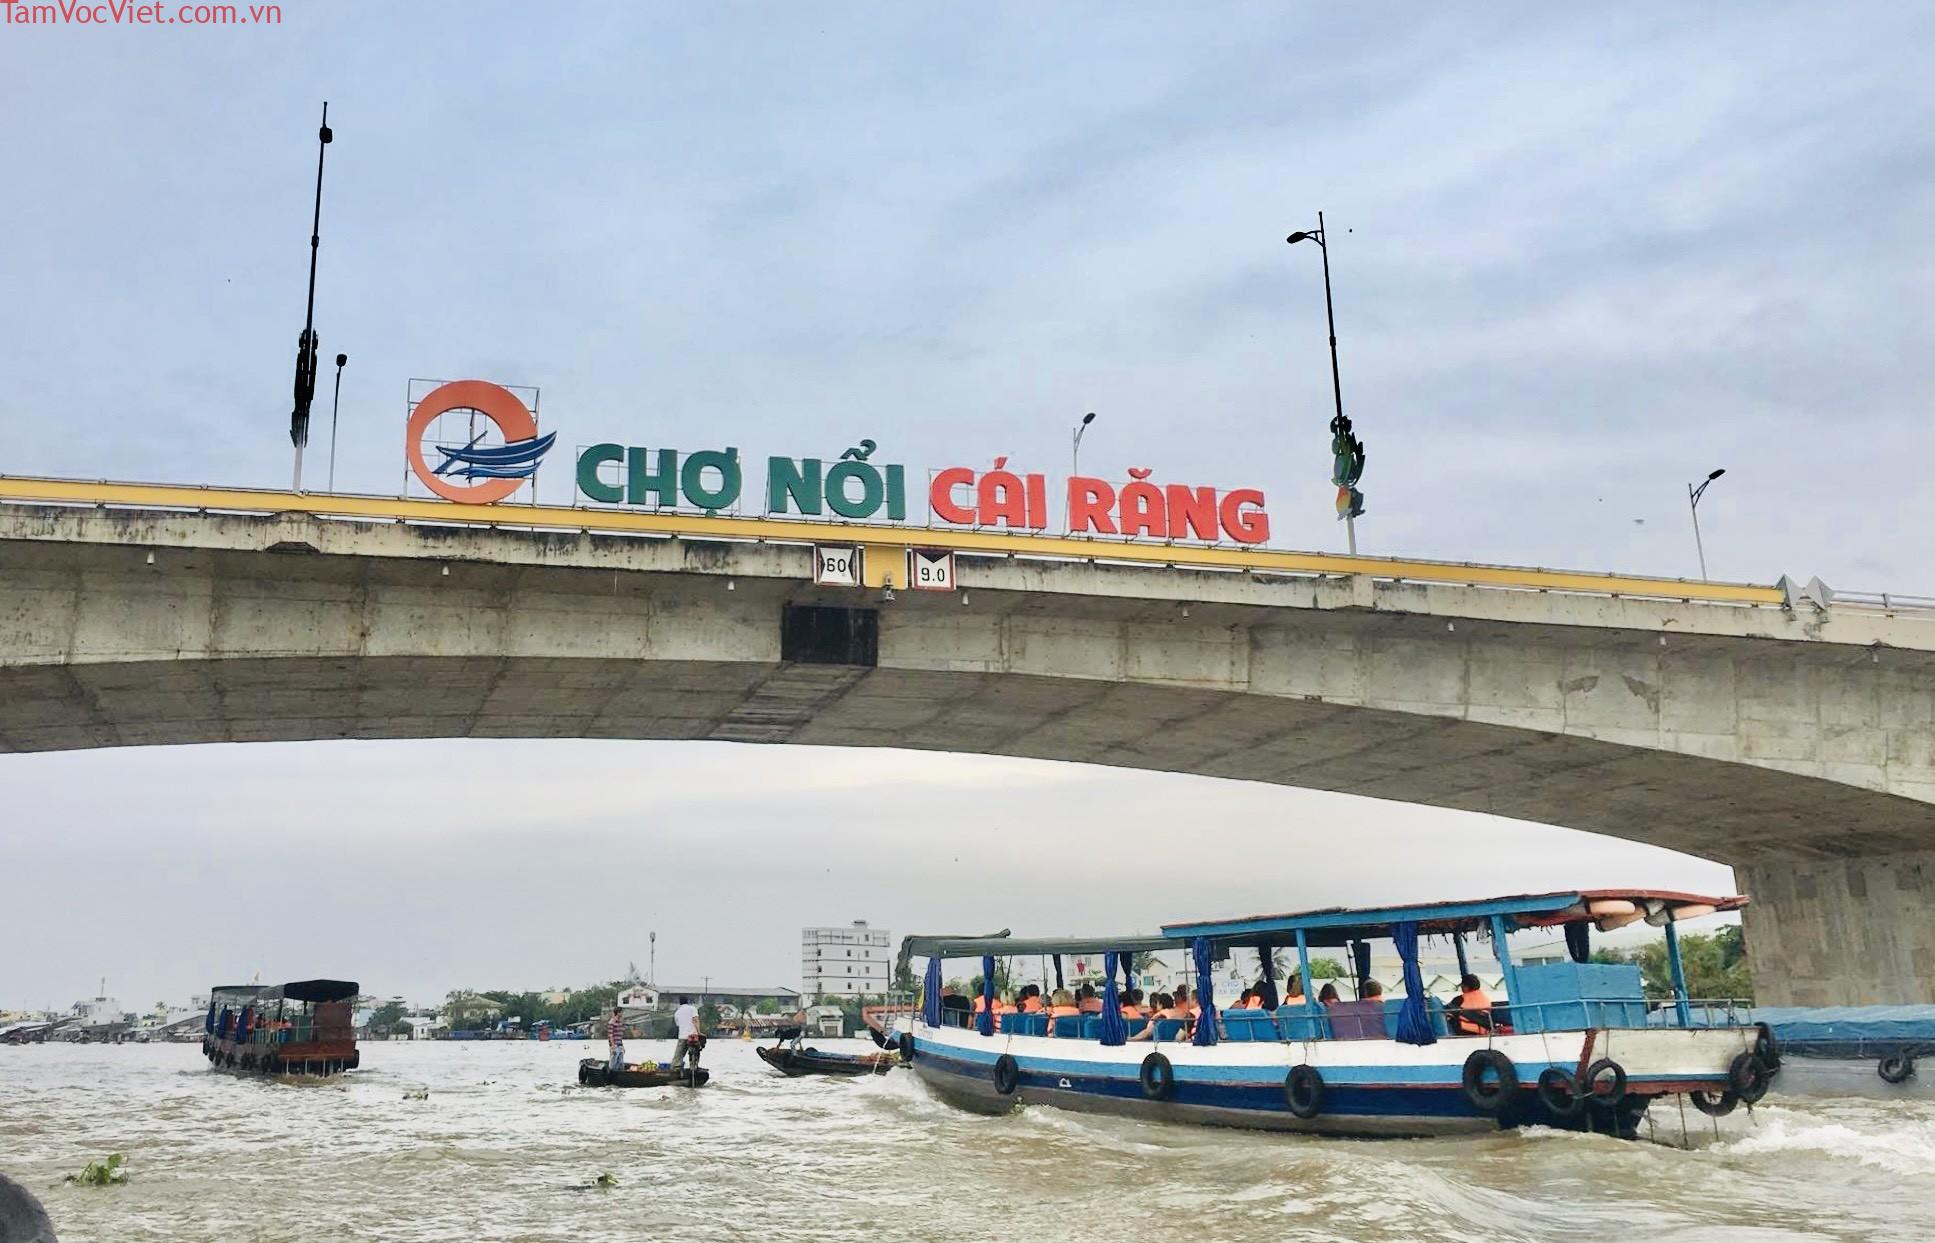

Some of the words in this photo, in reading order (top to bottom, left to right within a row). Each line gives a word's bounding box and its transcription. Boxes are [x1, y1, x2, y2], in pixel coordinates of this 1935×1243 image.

[577, 443, 742, 517] CHỢ
[768, 438, 906, 520] NỔI
[930, 456, 1047, 529] CÁI
[1068, 467, 1270, 544] RĂNG
[826, 557, 847, 573] 60
[921, 567, 946, 582] 9.0
